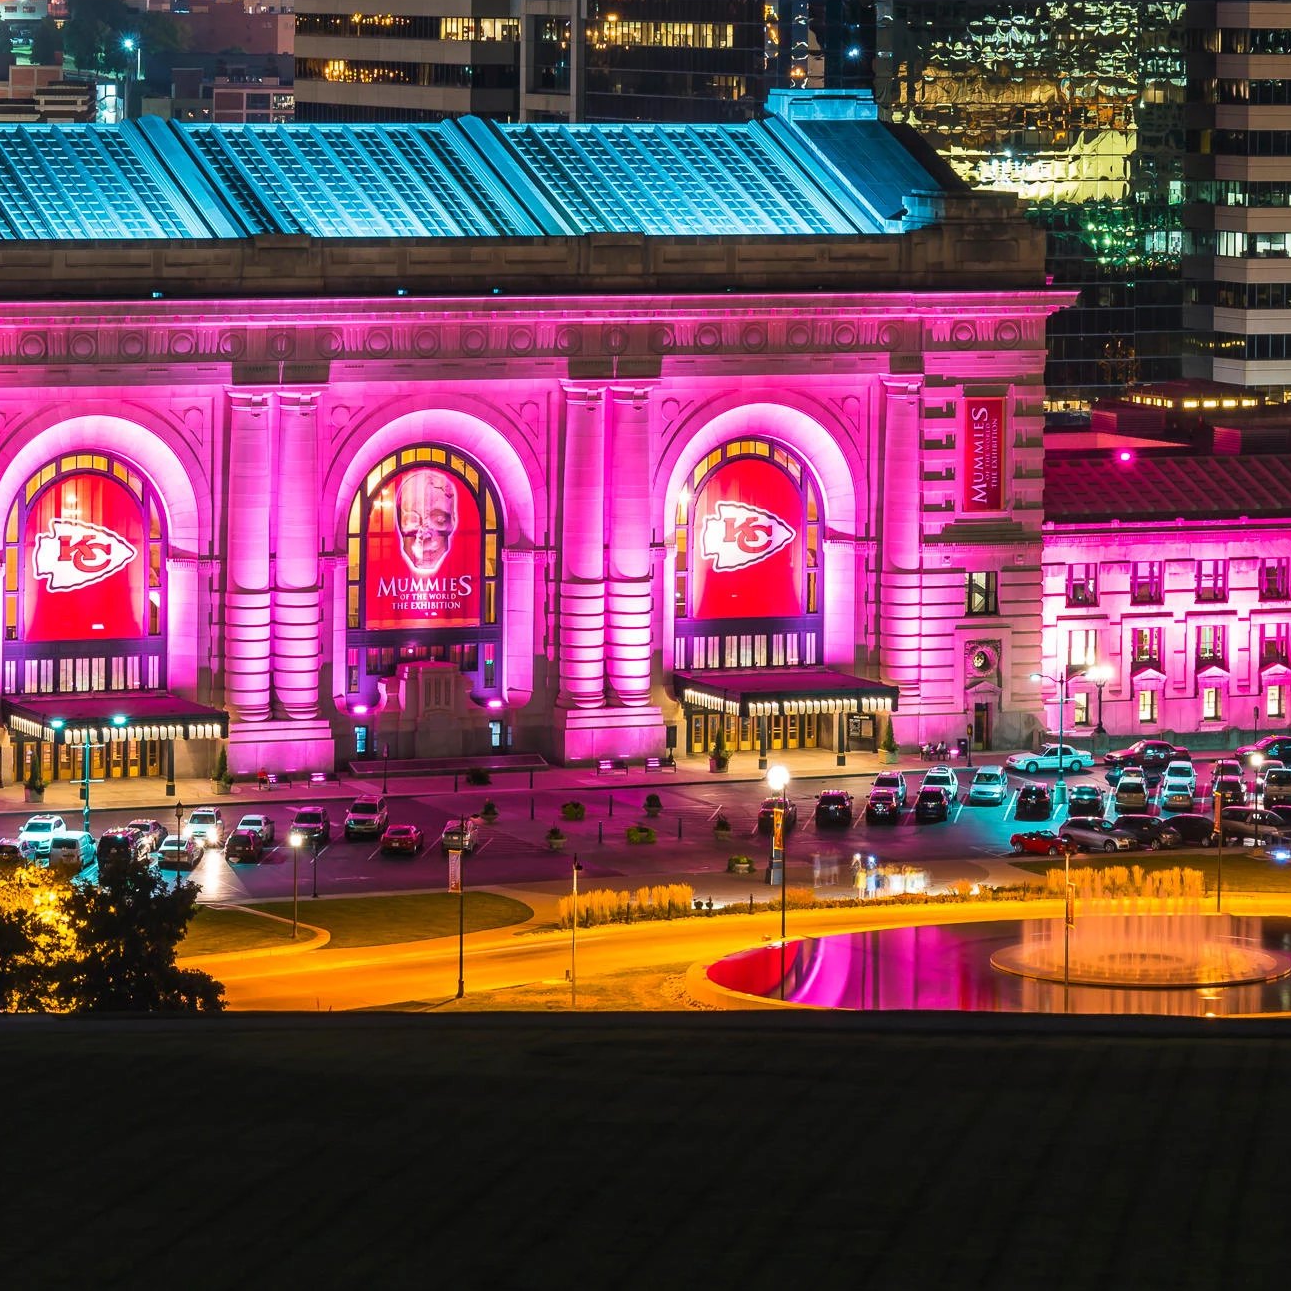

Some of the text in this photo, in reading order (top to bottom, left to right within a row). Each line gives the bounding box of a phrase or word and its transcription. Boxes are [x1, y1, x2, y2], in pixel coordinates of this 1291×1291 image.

[971, 407, 989, 503] MUMMIES
[57, 534, 112, 573] KC
[723, 516, 773, 554] KC
[376, 575, 472, 598] MUMMIES
[391, 601, 461, 610] THE EXHIBITION
